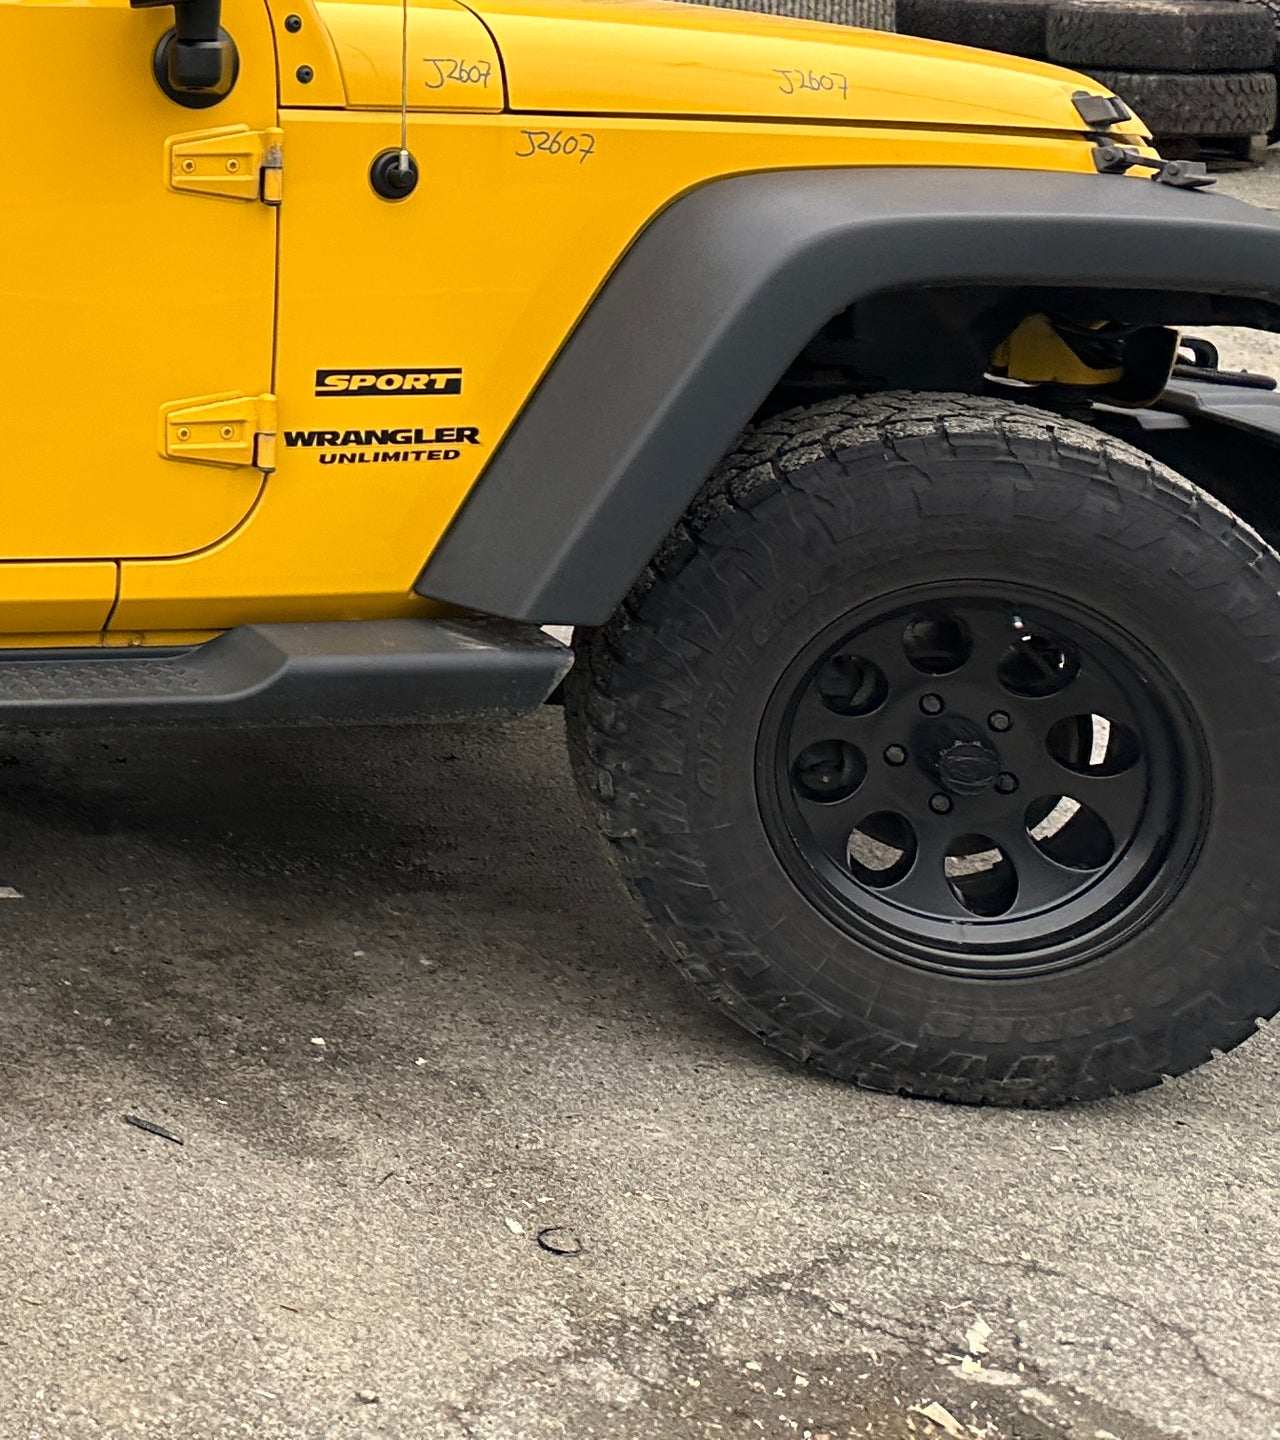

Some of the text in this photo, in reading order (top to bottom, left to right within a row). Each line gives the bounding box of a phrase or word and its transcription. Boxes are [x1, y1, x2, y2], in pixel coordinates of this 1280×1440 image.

[423, 57, 493, 89] J2607
[773, 68, 849, 100] J2607
[515, 130, 596, 164] J2607
[320, 373, 460, 391] SPORT
[283, 426, 481, 448] WRANGLER
[318, 449, 461, 465] UNLIMITED
